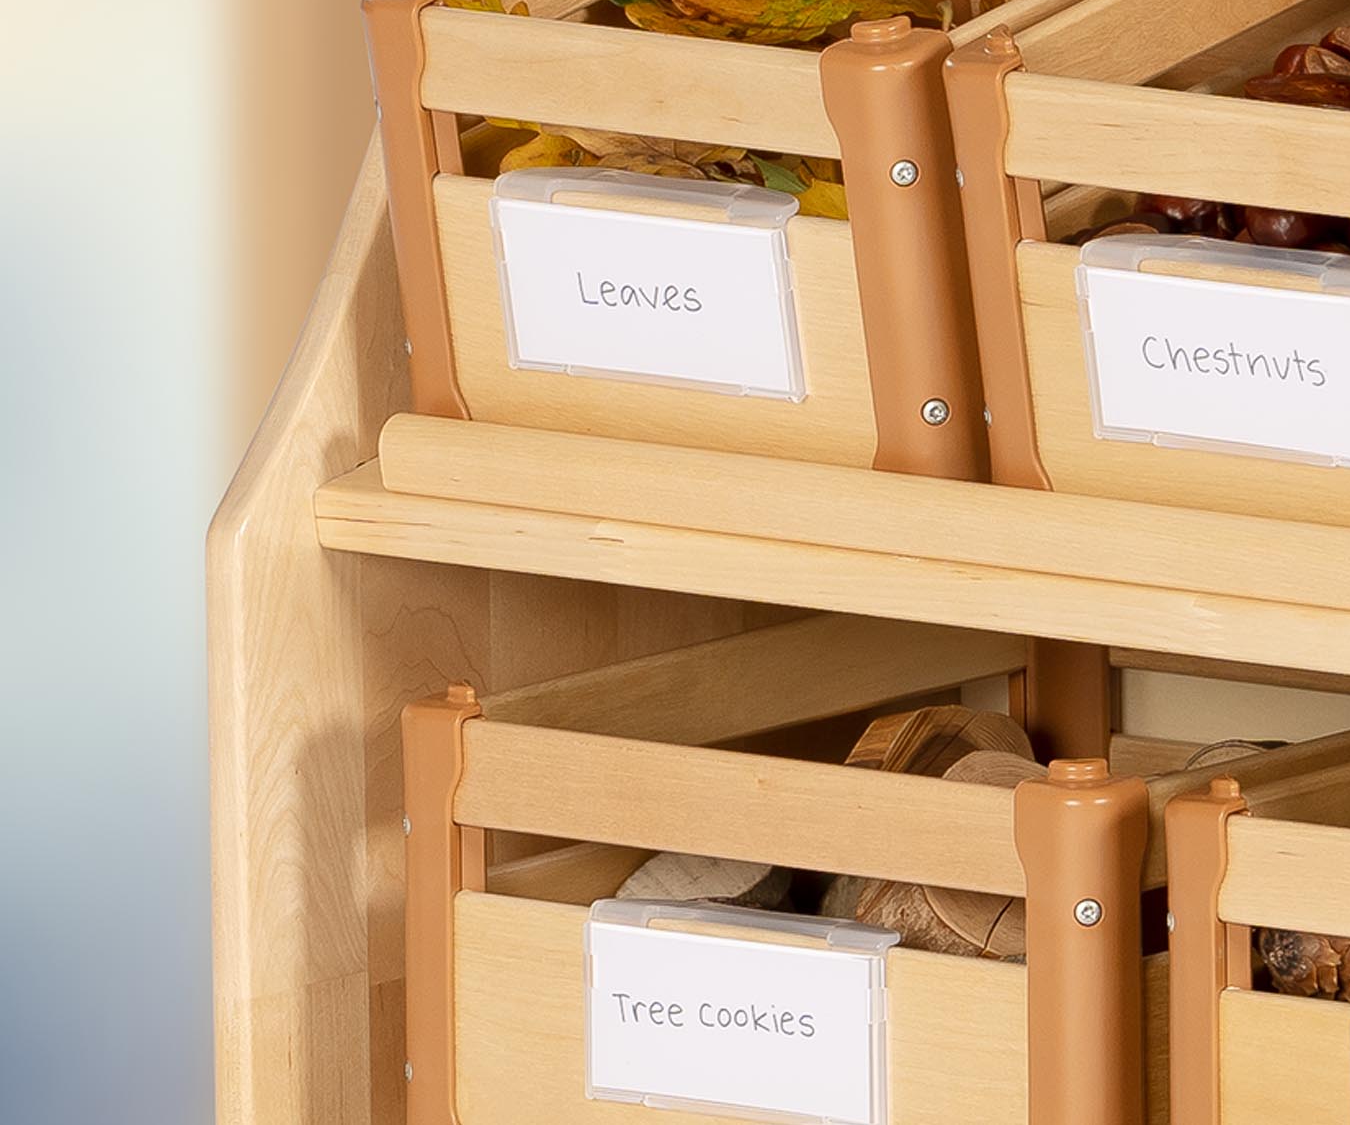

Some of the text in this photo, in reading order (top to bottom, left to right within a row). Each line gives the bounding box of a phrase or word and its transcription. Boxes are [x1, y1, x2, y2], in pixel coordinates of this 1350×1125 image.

[577, 272, 703, 313] Leaves
[1142, 336, 1327, 386] Chestnuts
[611, 993, 684, 1027] Tree
